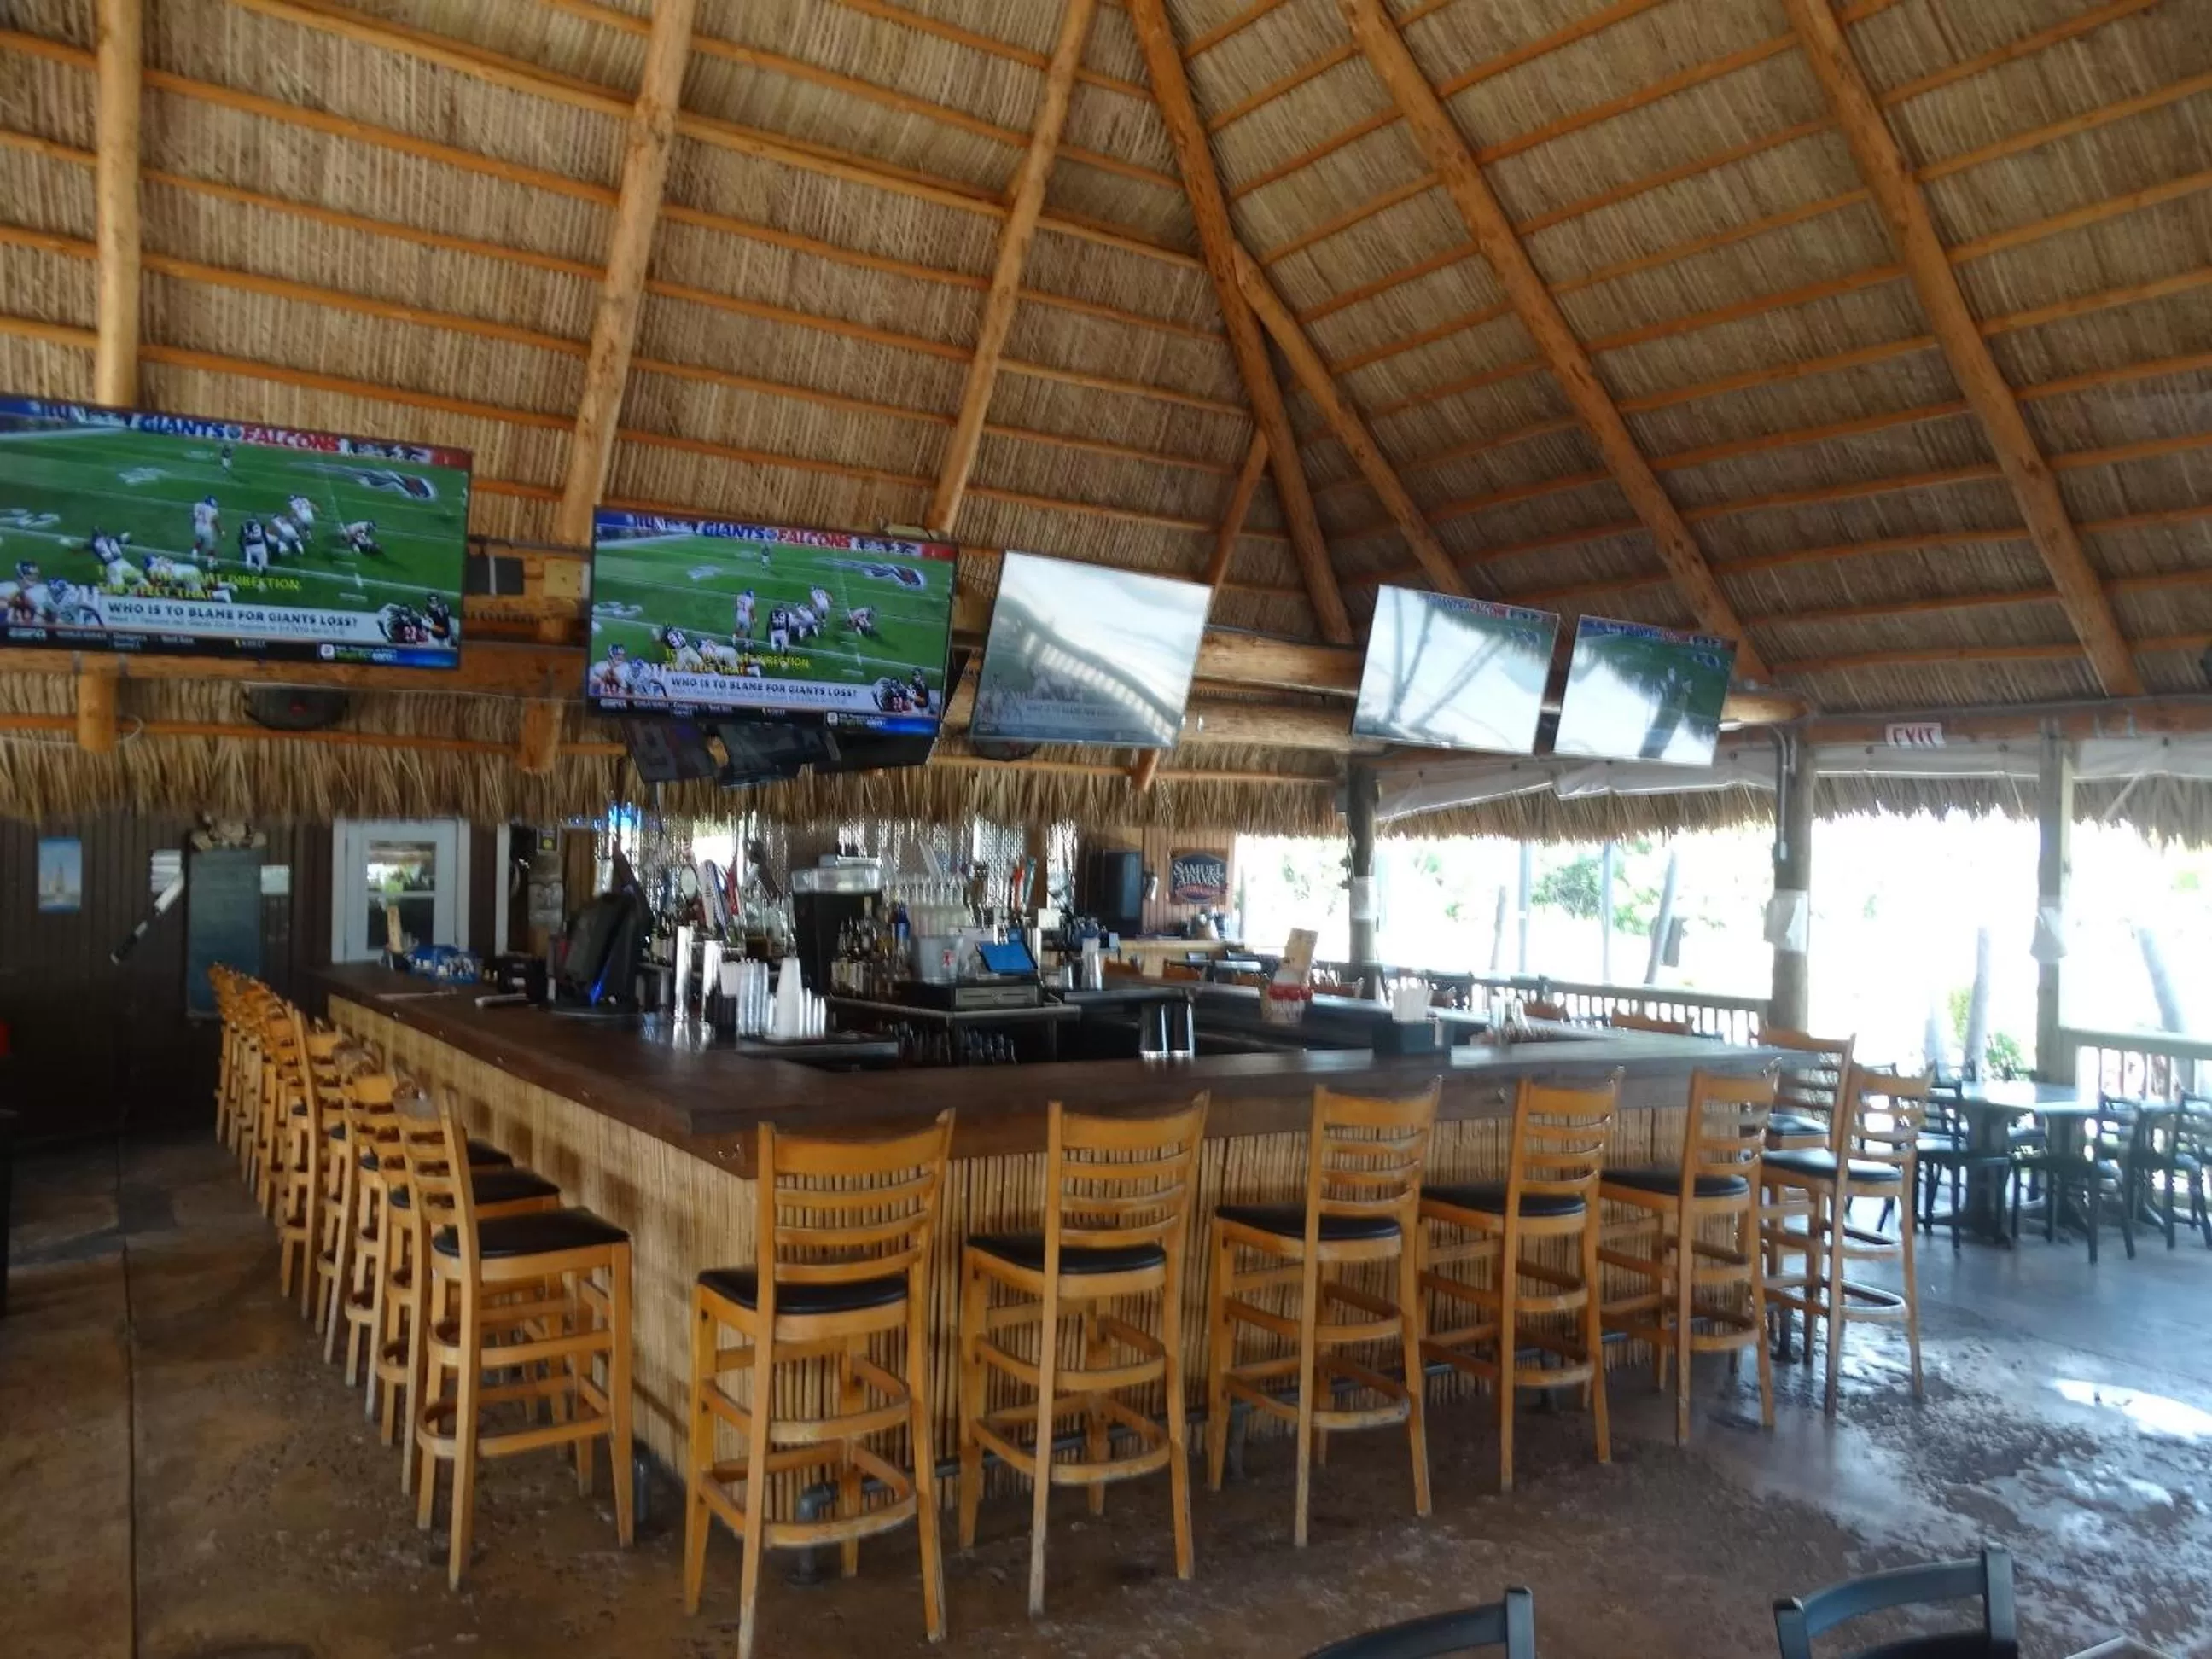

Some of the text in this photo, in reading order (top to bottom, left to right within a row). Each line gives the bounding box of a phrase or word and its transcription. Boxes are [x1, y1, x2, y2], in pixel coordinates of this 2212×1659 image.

[242, 426, 339, 452] FALCONS
[703, 521, 766, 541] GIANTS
[777, 528, 851, 549] FALCONS
[108, 601, 358, 627] WHO IS TO BLAME FOR GIANTS LOSS?
[672, 677, 696, 687] WHO
[700, 678, 709, 688] IS
[713, 679, 726, 690] TO
[730, 680, 763, 691] BLAME
[766, 683, 786, 693] FOR
[789, 685, 825, 696] GIANTS
[1173, 860, 1225, 877] SAMUEL
